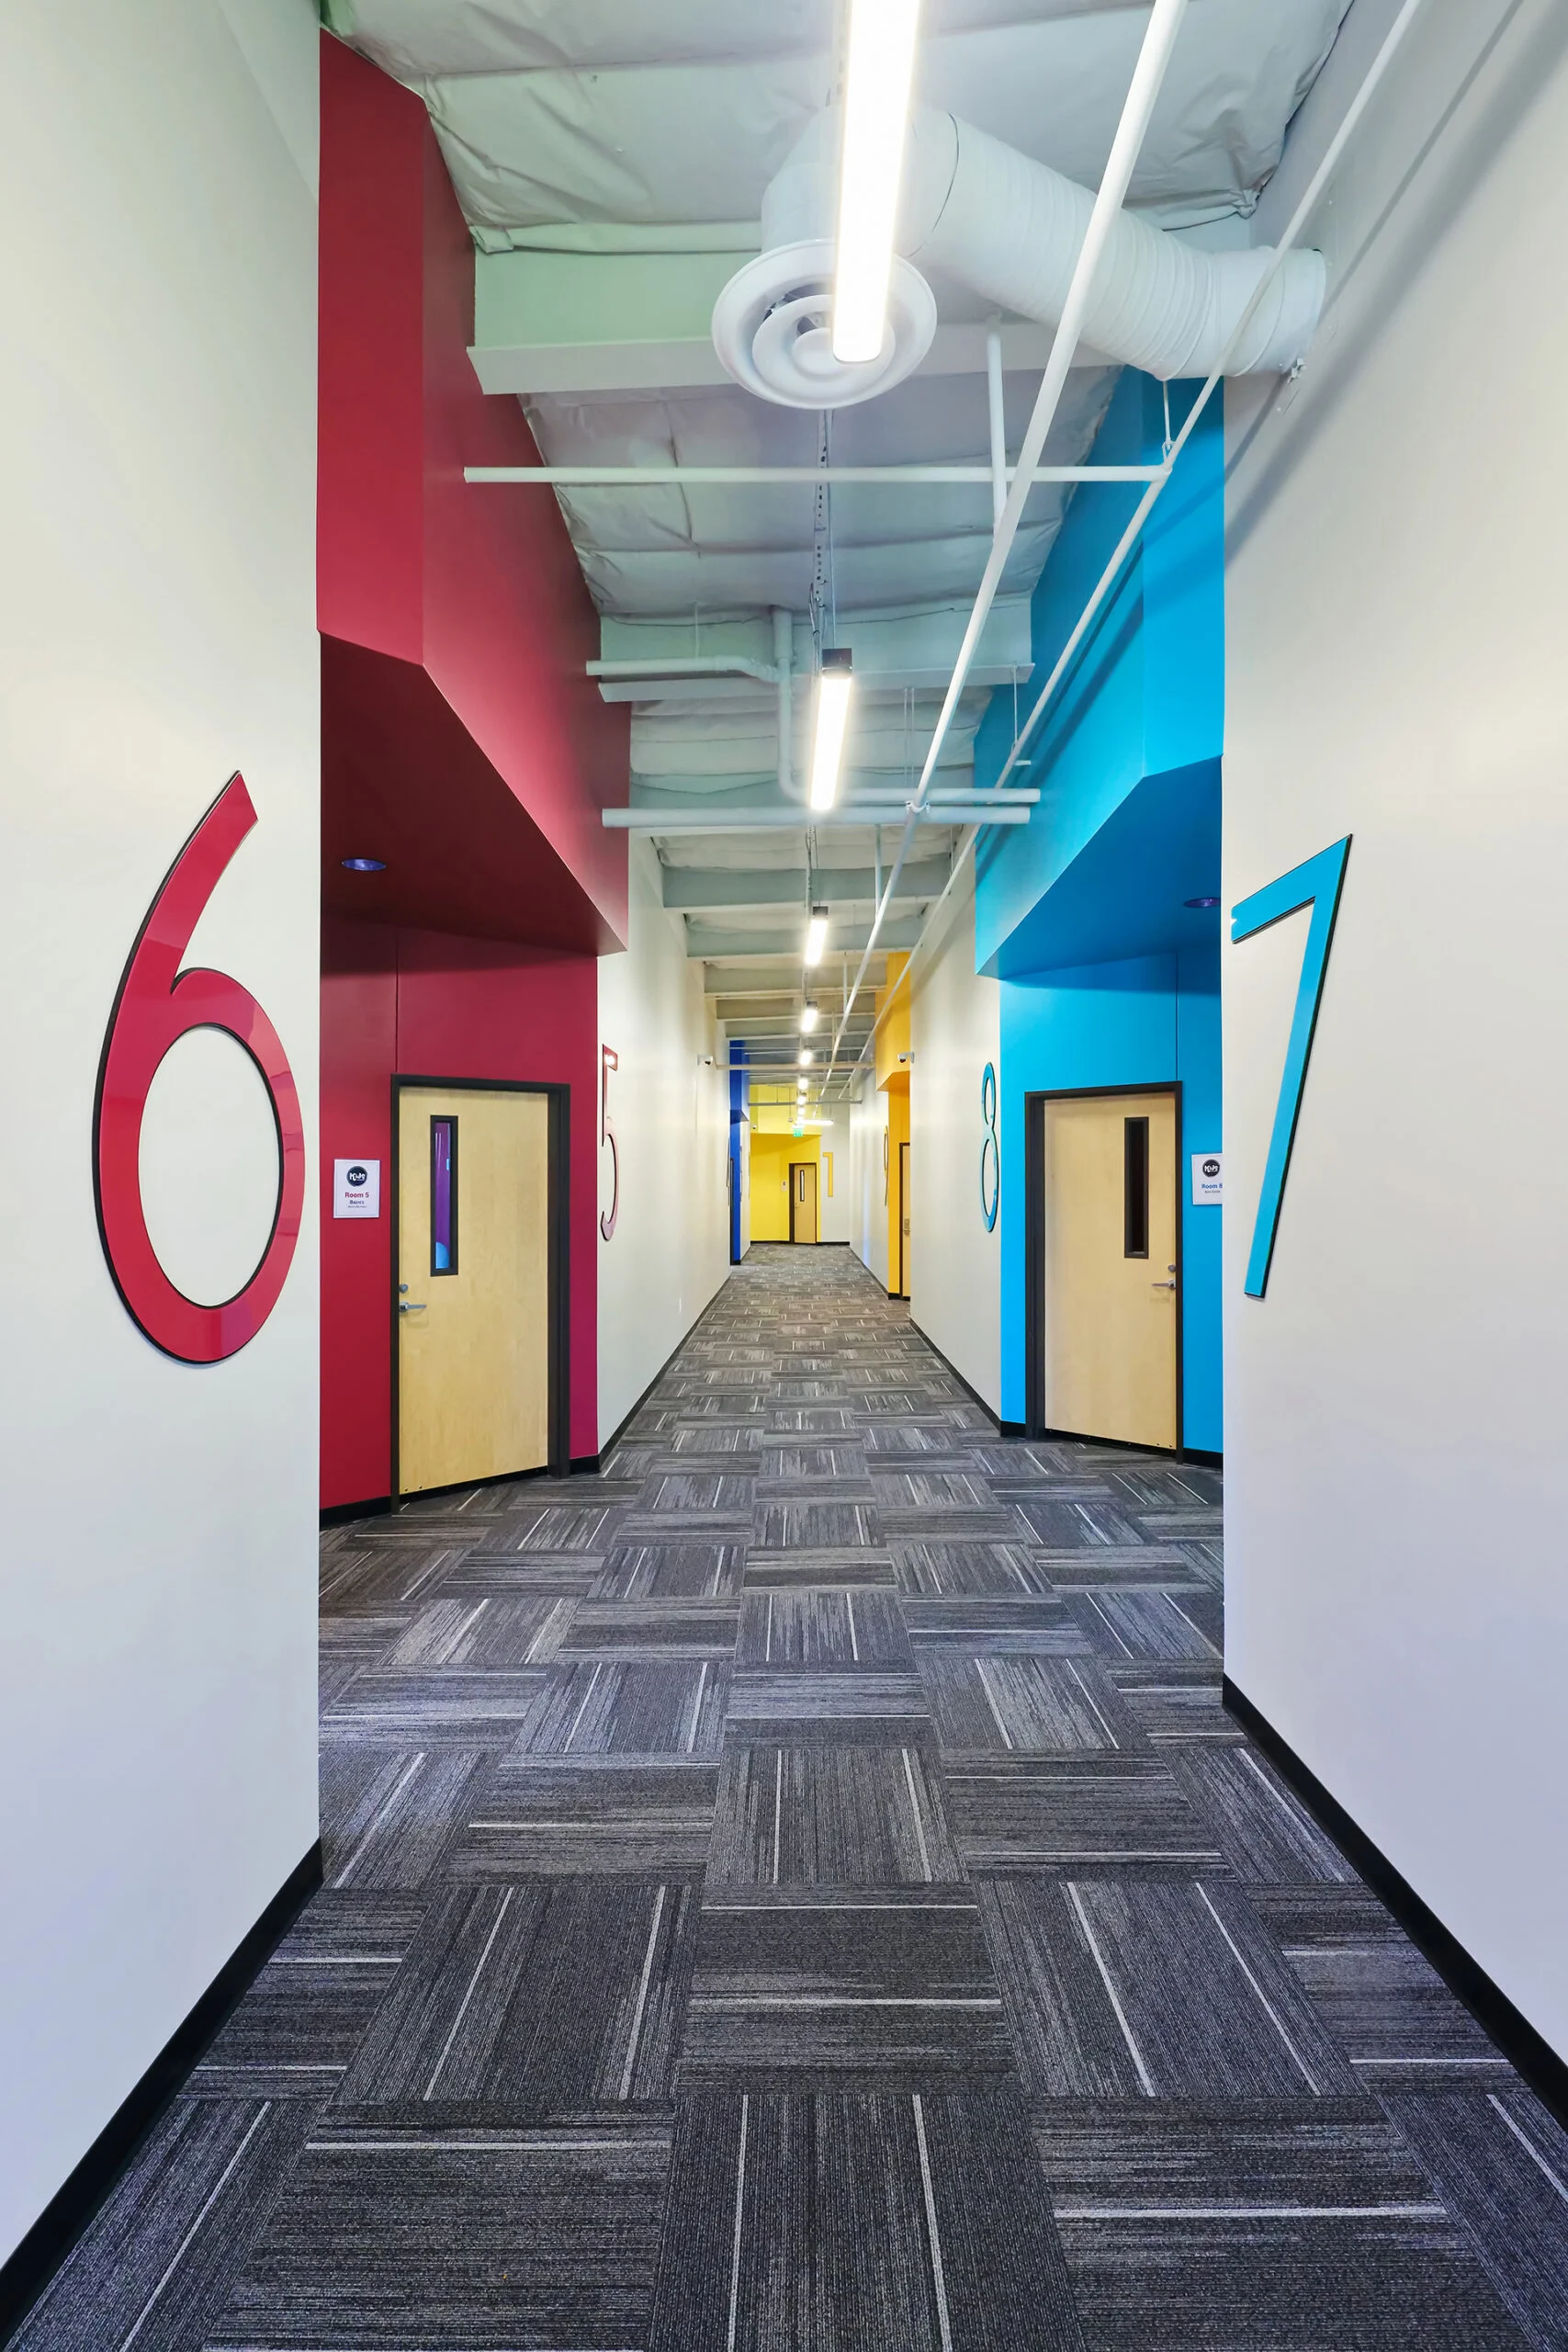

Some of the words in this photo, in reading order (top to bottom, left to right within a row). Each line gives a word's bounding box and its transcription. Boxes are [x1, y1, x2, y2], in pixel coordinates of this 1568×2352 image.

[90, 770, 306, 1365] 6
[600, 1044, 619, 1241] 5
[979, 1061, 999, 1233] 8
[1230, 833, 1353, 1299] 7
[822, 1151, 834, 1198] 1
